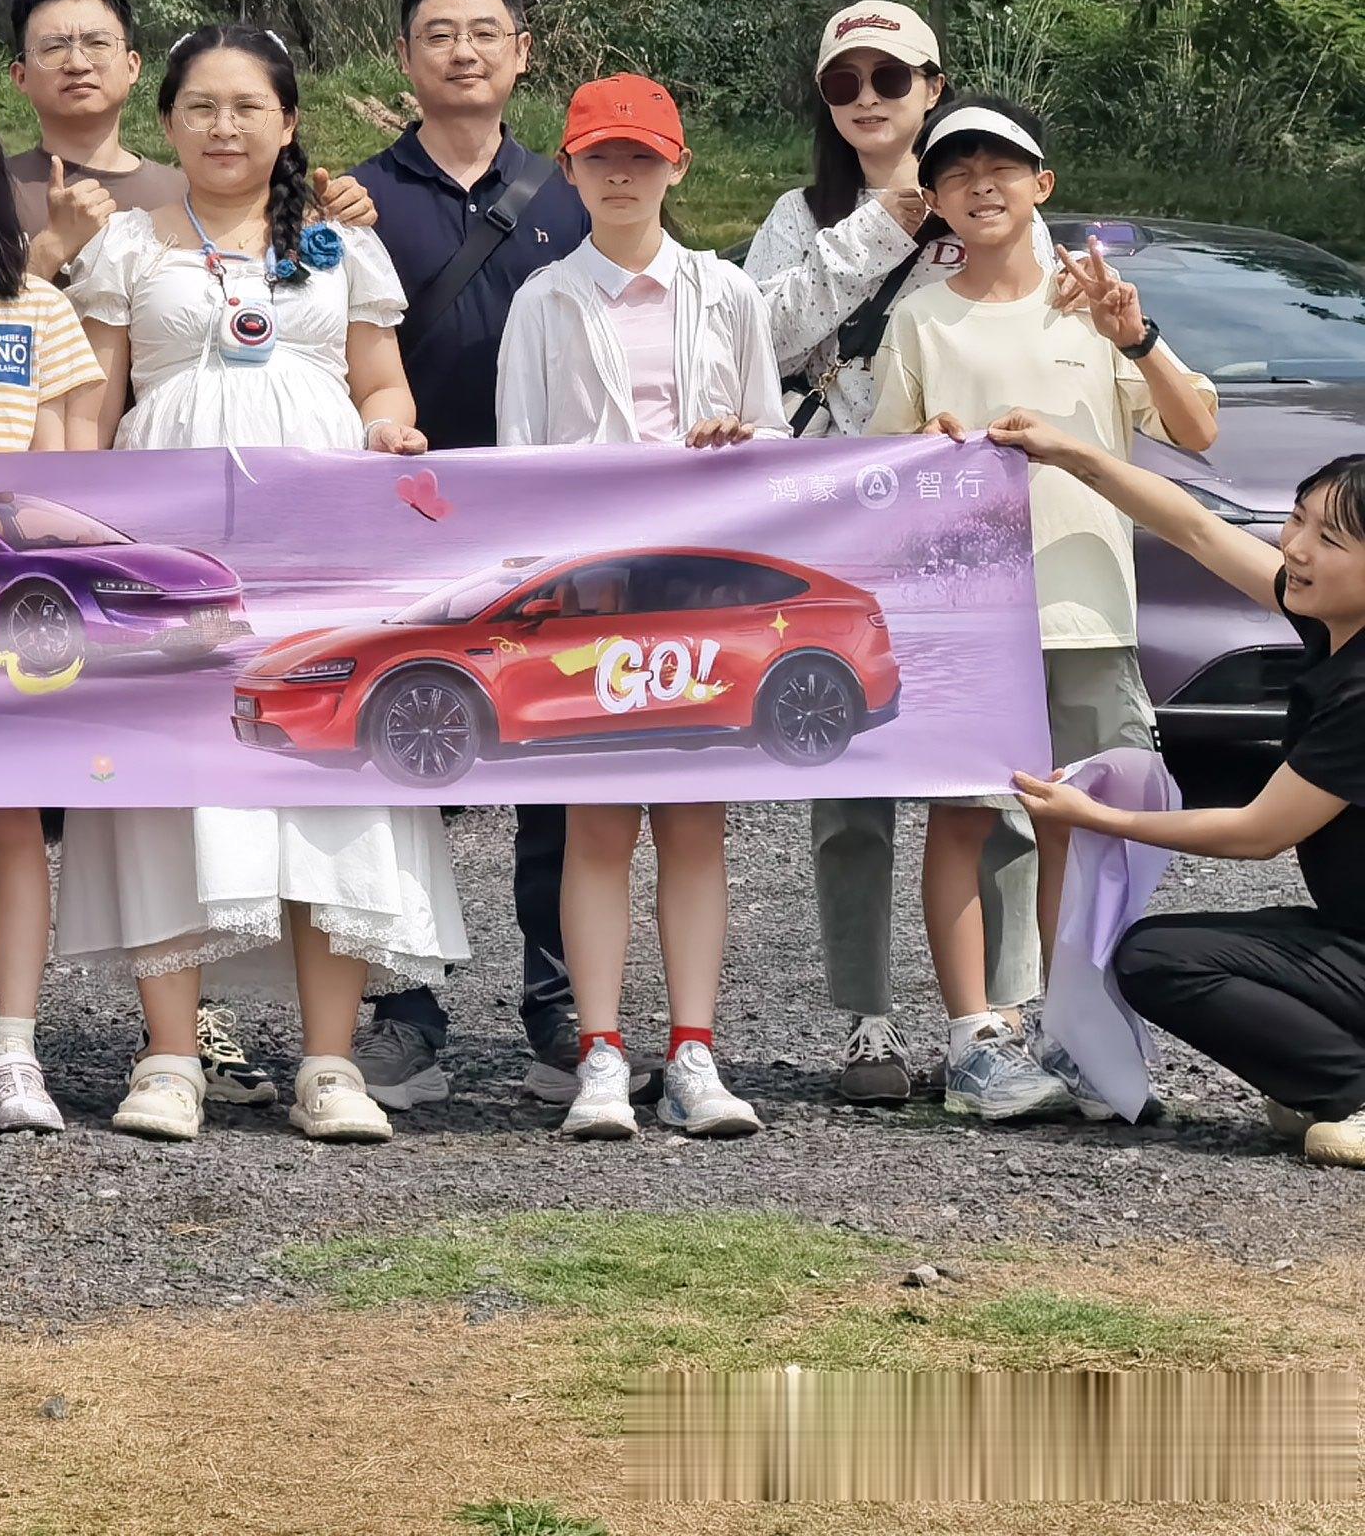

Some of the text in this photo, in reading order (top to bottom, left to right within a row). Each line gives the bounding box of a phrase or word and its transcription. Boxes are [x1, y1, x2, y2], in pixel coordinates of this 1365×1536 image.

[768, 469, 986, 503] 鸿蒙 智行
[595, 638, 720, 714] GO!
